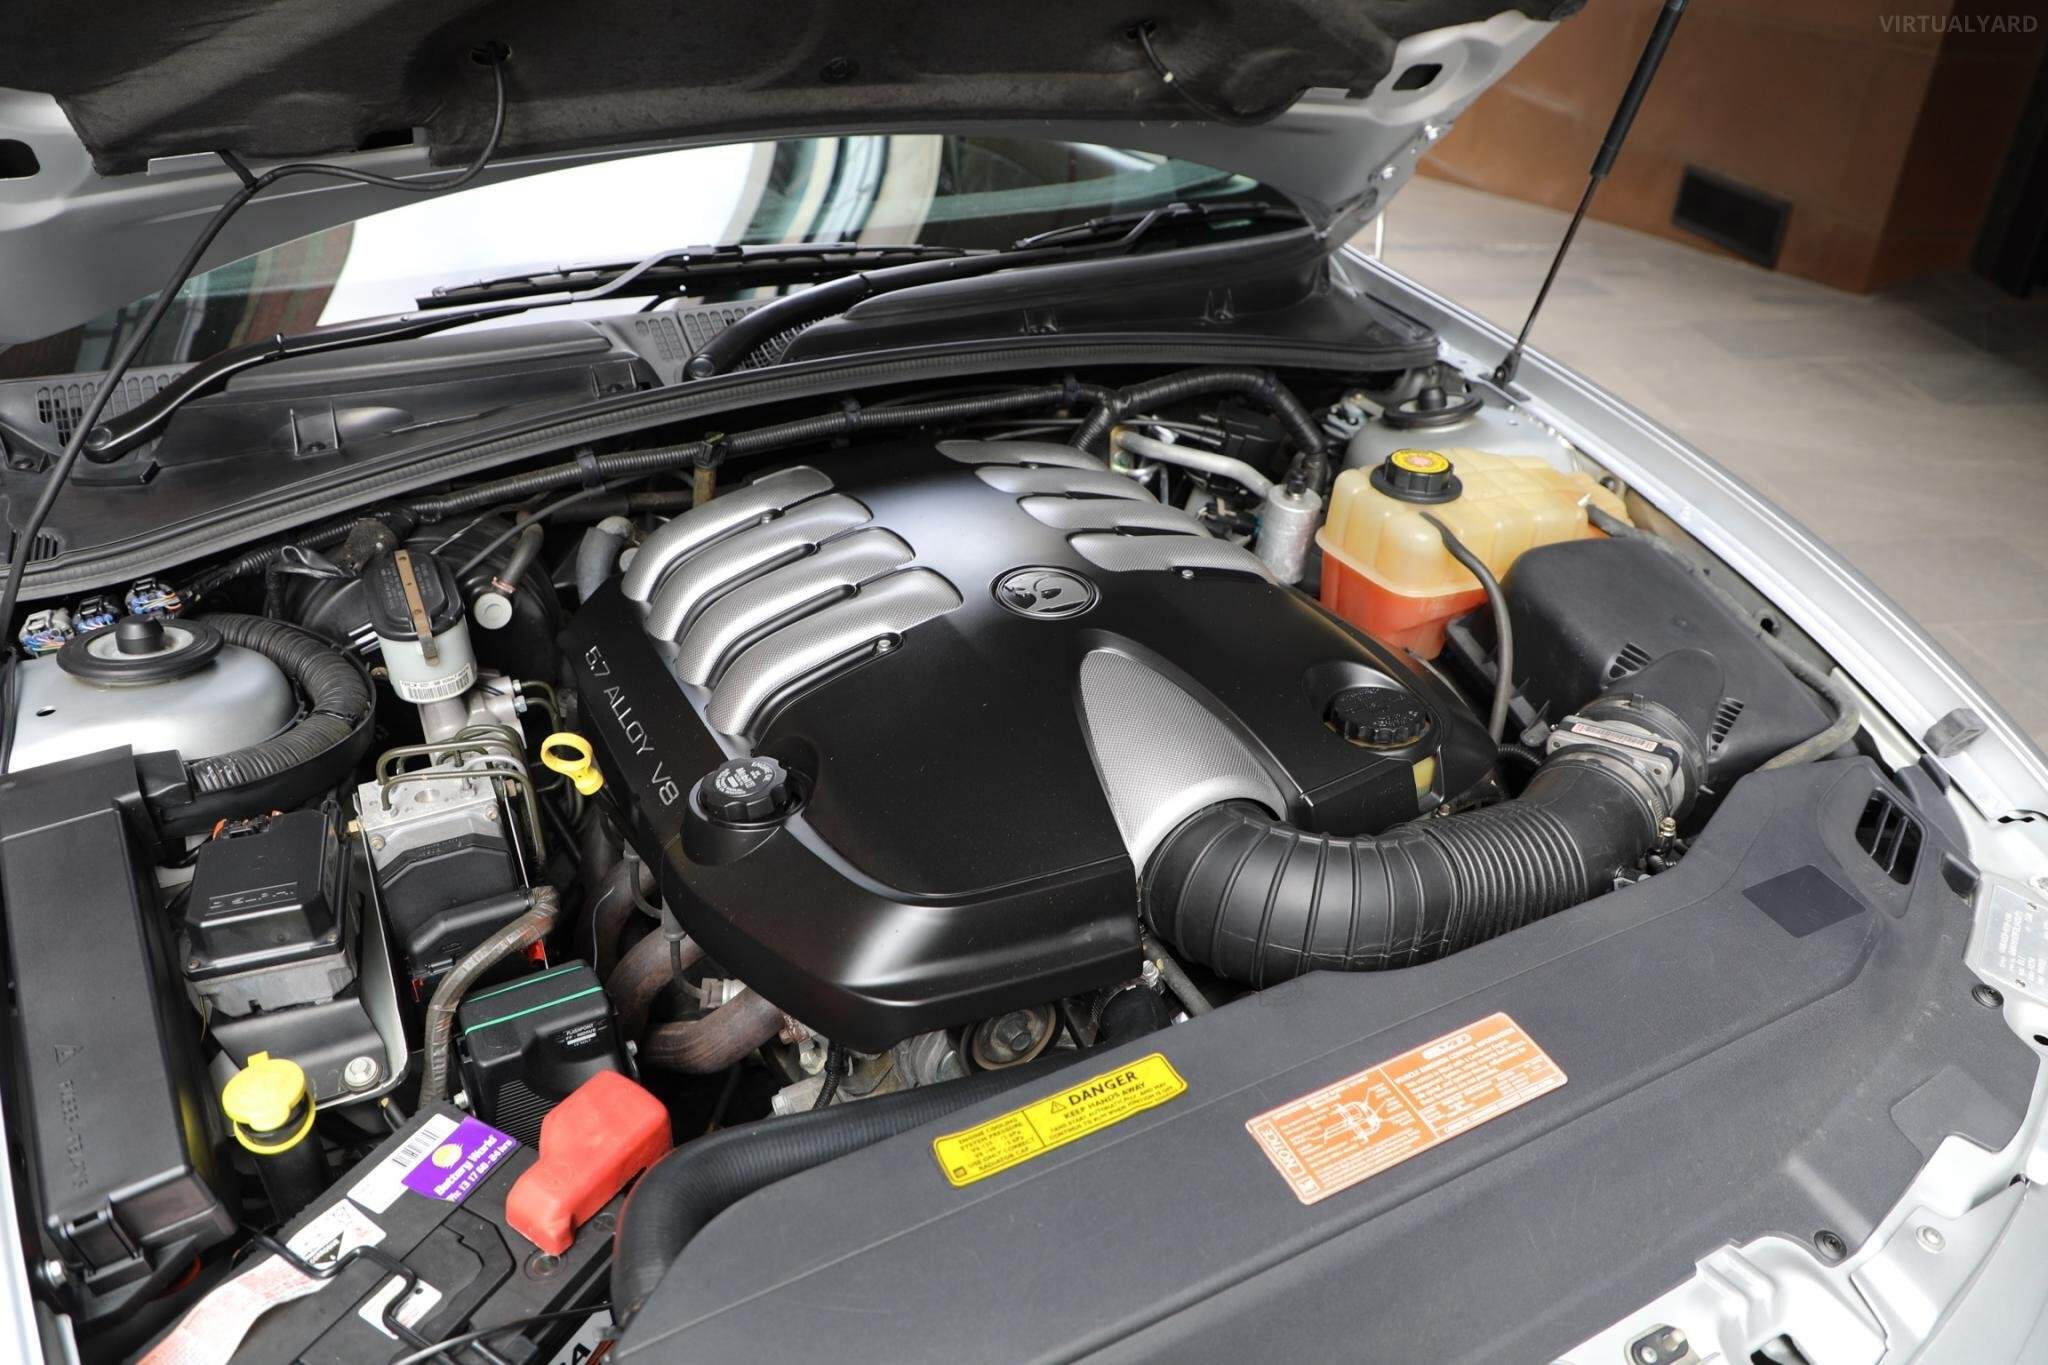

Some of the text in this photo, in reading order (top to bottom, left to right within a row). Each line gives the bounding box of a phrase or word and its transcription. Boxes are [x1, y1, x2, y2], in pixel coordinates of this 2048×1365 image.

[586, 646, 680, 806] 5.7 ALLOY V8
[1063, 1081, 1147, 1119] KEEP HANDS AWAY
[1068, 1072, 1137, 1105] DANGER
[433, 1134, 497, 1196] Battery World
